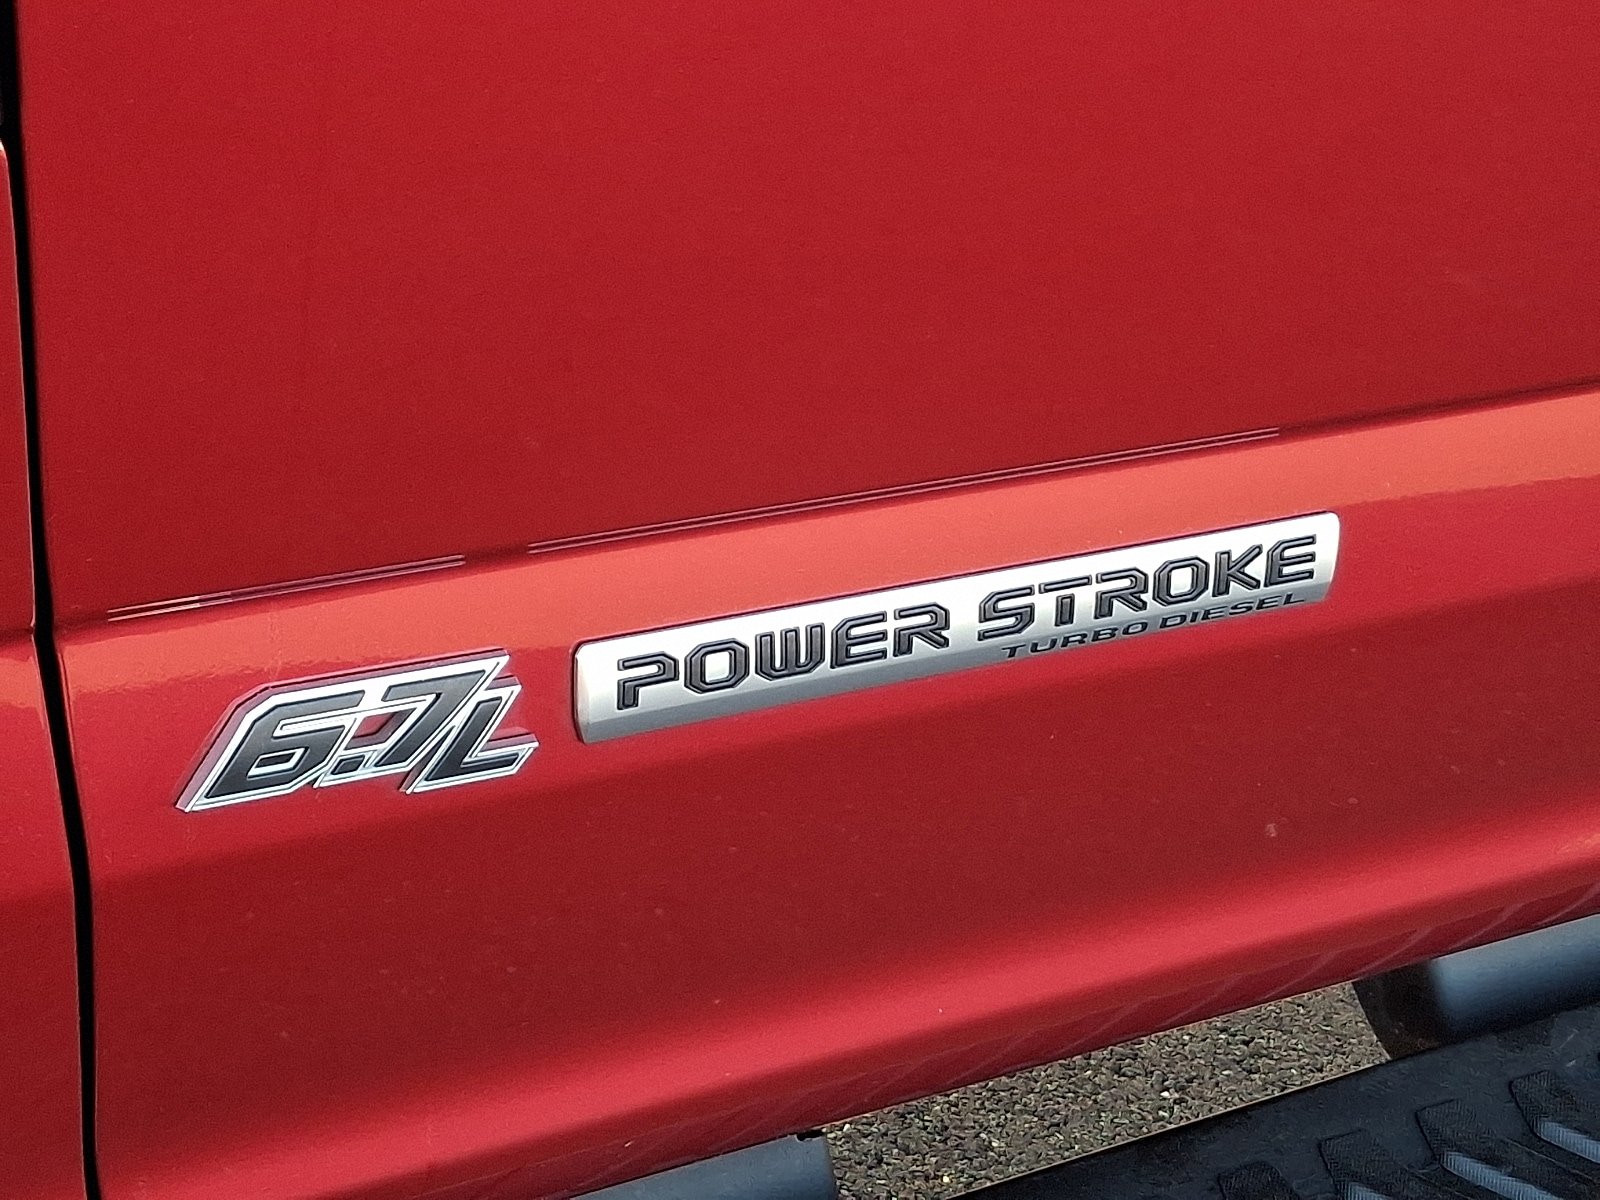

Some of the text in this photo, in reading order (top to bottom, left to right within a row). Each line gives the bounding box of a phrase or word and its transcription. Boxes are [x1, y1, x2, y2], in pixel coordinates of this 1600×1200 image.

[617, 534, 1317, 711] POWER STROKE
[1001, 591, 1306, 658] TURBO DIESEL
[189, 658, 535, 808] 6.7L
